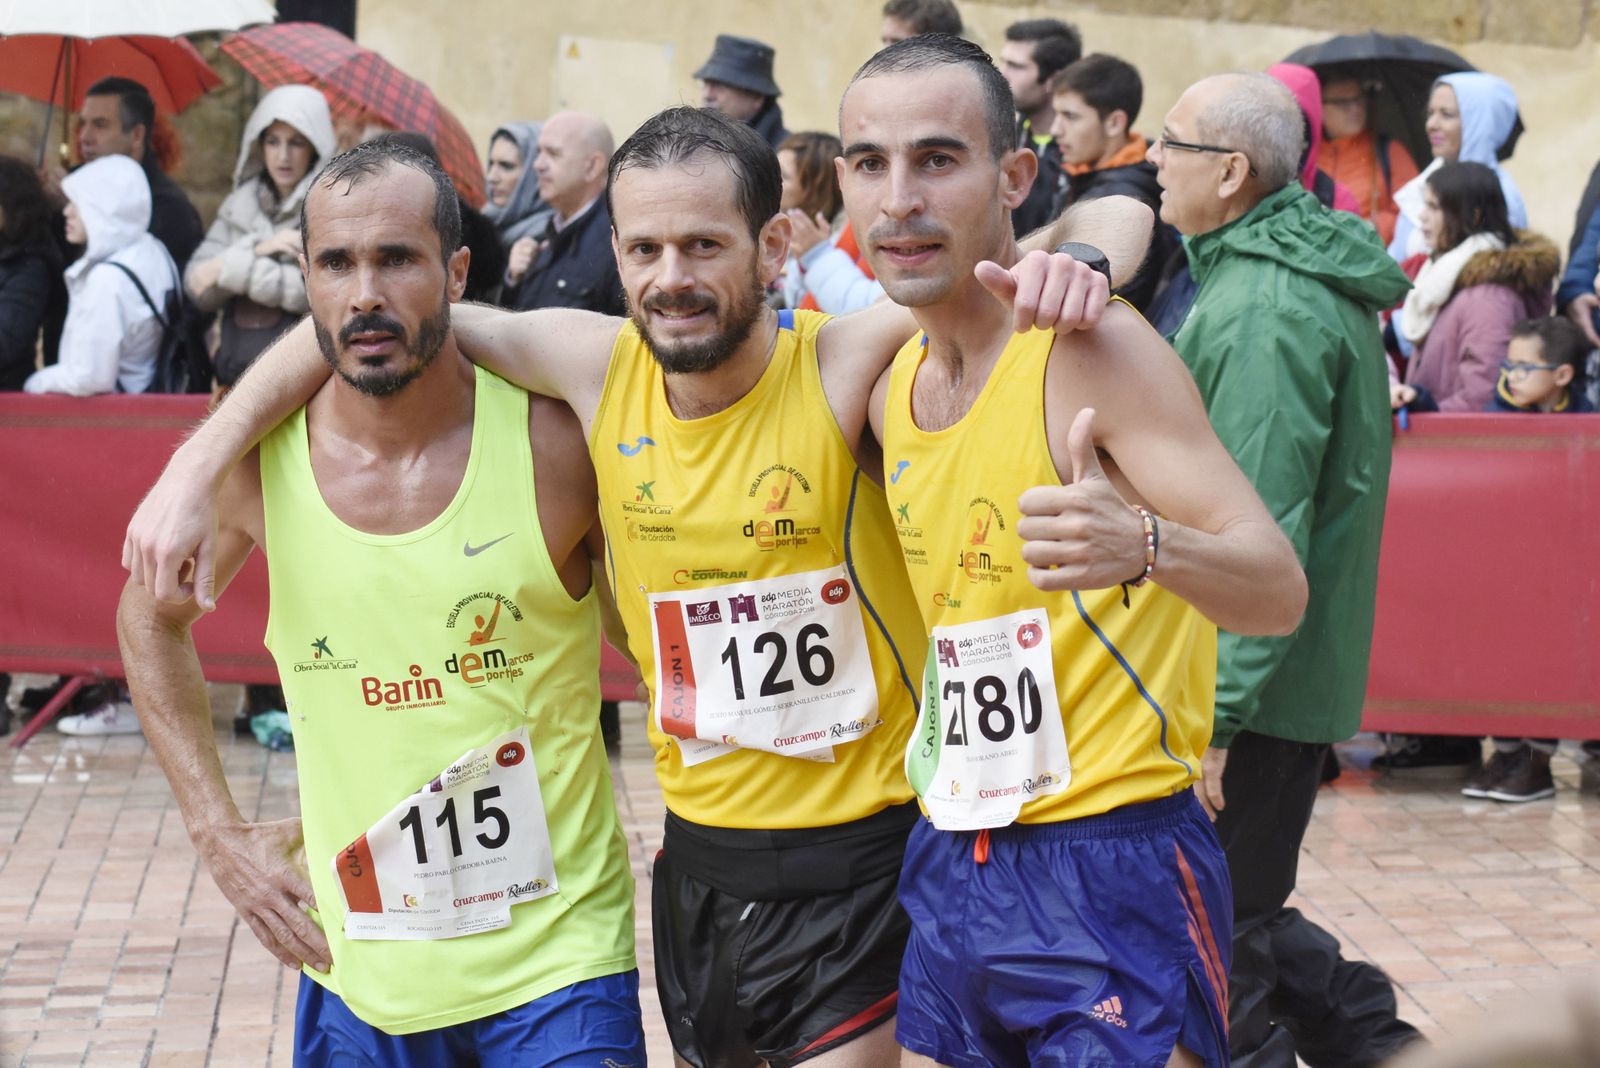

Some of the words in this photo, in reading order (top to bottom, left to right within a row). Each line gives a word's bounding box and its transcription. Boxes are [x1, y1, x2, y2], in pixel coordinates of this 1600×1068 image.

[748, 478, 761, 497] ESCUELA
[787, 467, 797, 475] DE
[639, 524, 675, 533] Diputación
[761, 592, 777, 604] edp
[777, 587, 812, 600] MEDIA
[828, 586, 844, 597] edp
[446, 607, 460, 628] ESCUELA
[456, 592, 494, 609] PROVINCIAL
[494, 594, 506, 602] DE
[762, 597, 814, 613] MARATÓN
[689, 613, 721, 623] IMDECO
[959, 638, 974, 649] edp
[974, 632, 1008, 644] MEDIA
[961, 642, 1010, 659] MARATÓN
[996, 652, 1012, 661] 2018
[294, 664, 312, 672] Obra
[721, 623, 835, 701] 126
[406, 700, 446, 710] INMOBILIARIO
[773, 730, 827, 748] Cruzcampo
[503, 749, 517, 759] edp
[979, 785, 1020, 799] Cruzcampo
[399, 785, 511, 864] 115
[414, 871, 434, 879] PEDRO
[434, 868, 454, 877] PABLO
[485, 856, 508, 866] BAENA
[453, 891, 504, 908] Cruzcampo
[506, 879, 543, 899] Radler
